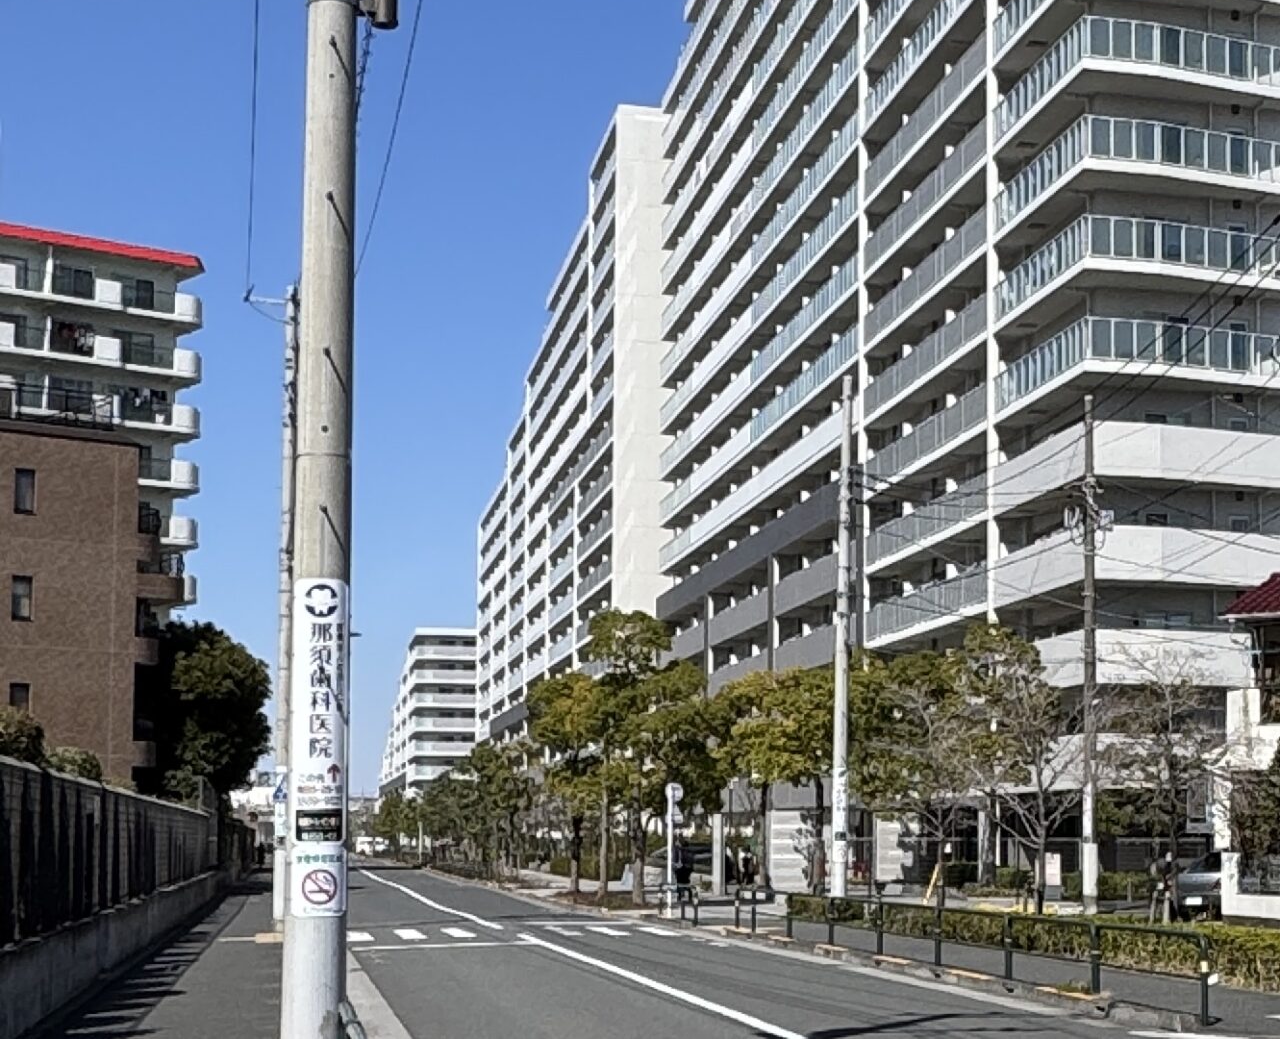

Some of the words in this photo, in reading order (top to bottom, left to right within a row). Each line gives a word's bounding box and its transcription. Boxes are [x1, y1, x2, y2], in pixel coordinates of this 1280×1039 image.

[310, 623, 332, 758] 那須歯科医院
